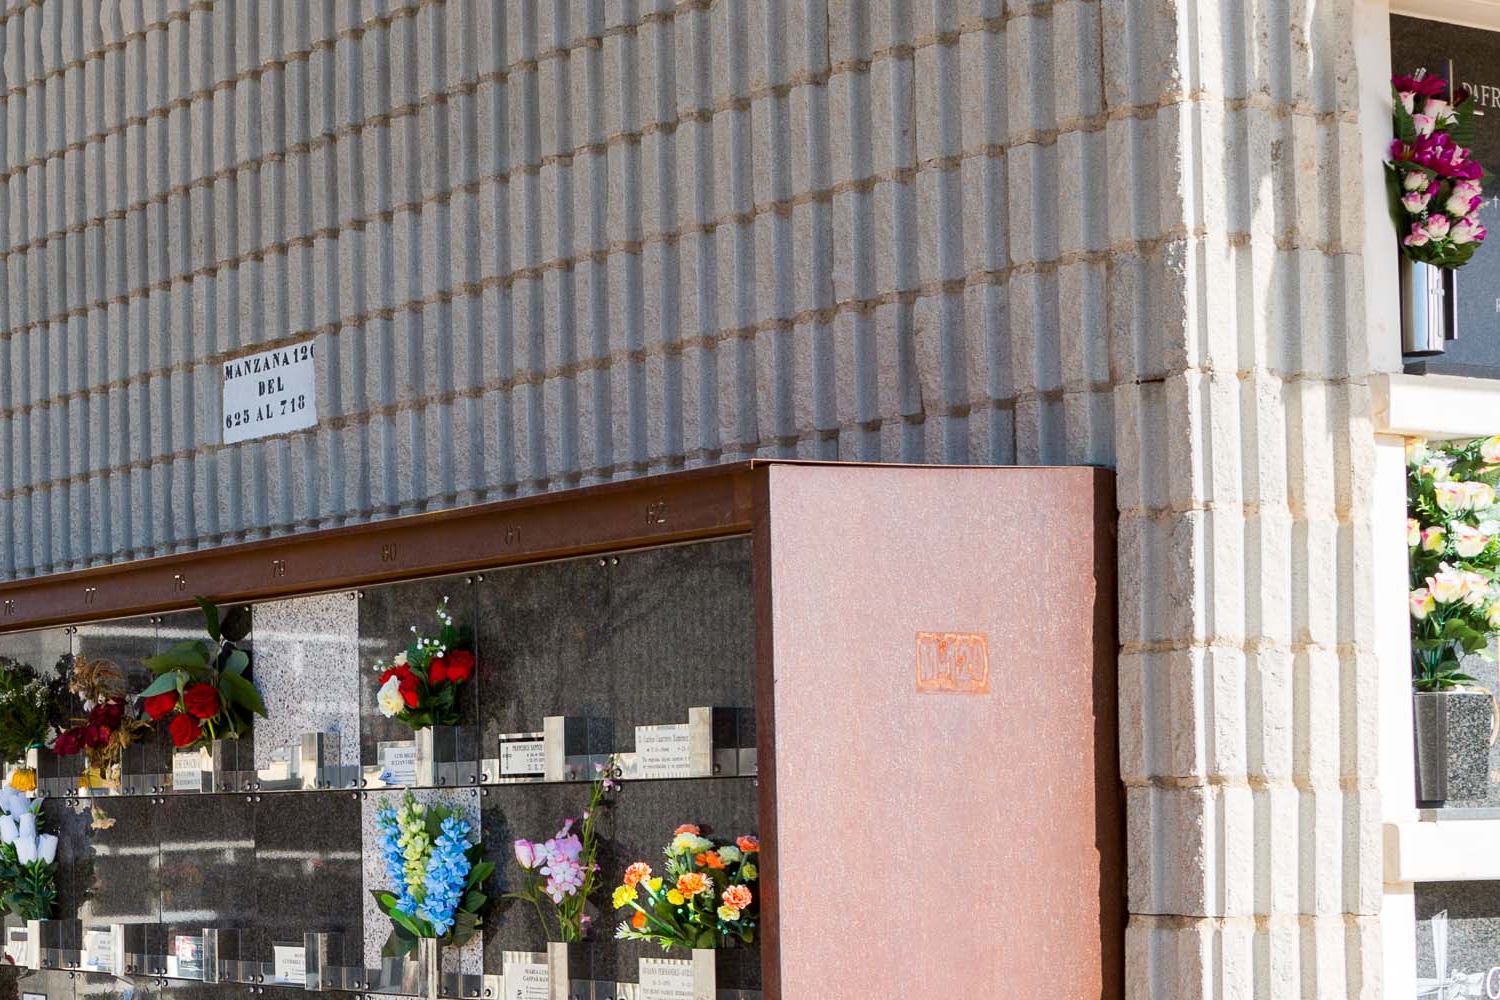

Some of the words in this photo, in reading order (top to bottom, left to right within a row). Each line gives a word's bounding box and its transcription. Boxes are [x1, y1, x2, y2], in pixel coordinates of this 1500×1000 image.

[225, 351, 290, 380] MANZANA
[258, 376, 284, 396] DEL
[226, 409, 250, 429] 625
[256, 403, 273, 422] AL
[280, 394, 305, 415] 718
